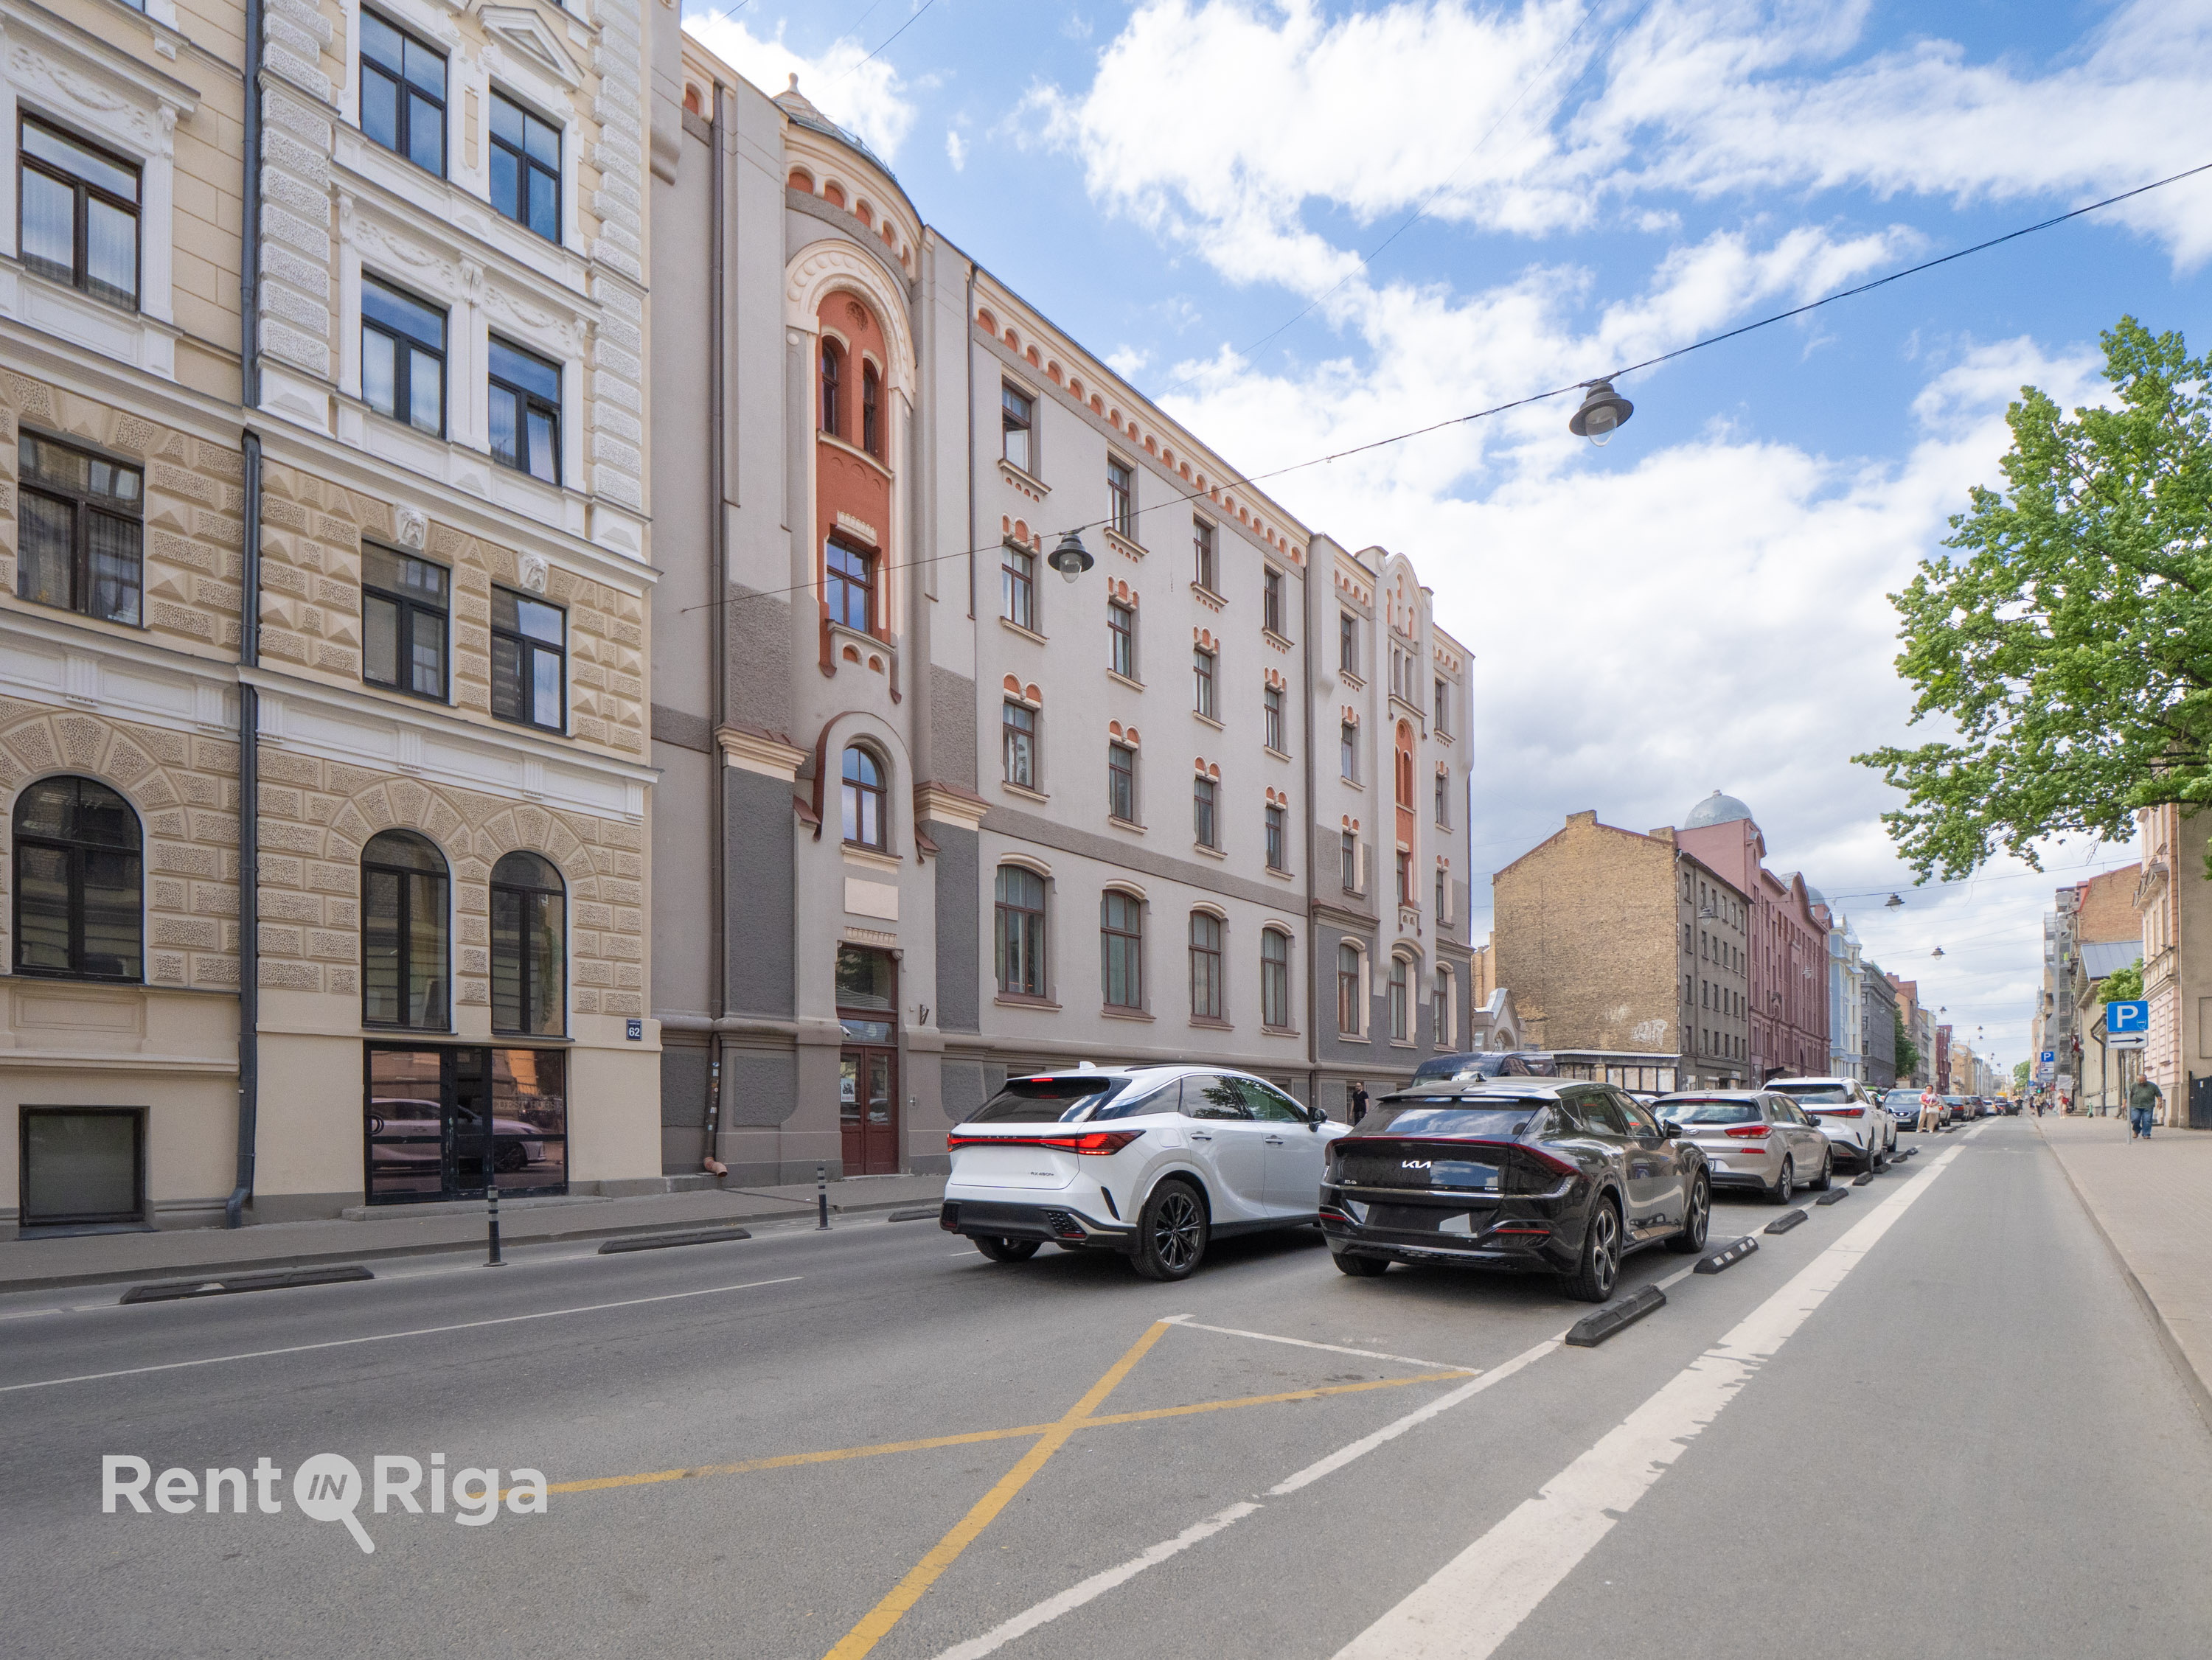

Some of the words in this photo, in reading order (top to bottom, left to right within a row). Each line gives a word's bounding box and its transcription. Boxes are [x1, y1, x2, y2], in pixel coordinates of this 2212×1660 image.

[2117, 1005, 2138, 1028] P
[629, 1027, 640, 1036] 62
[2043, 1053, 2051, 1061] P
[1402, 1160, 1431, 1168] KIA
